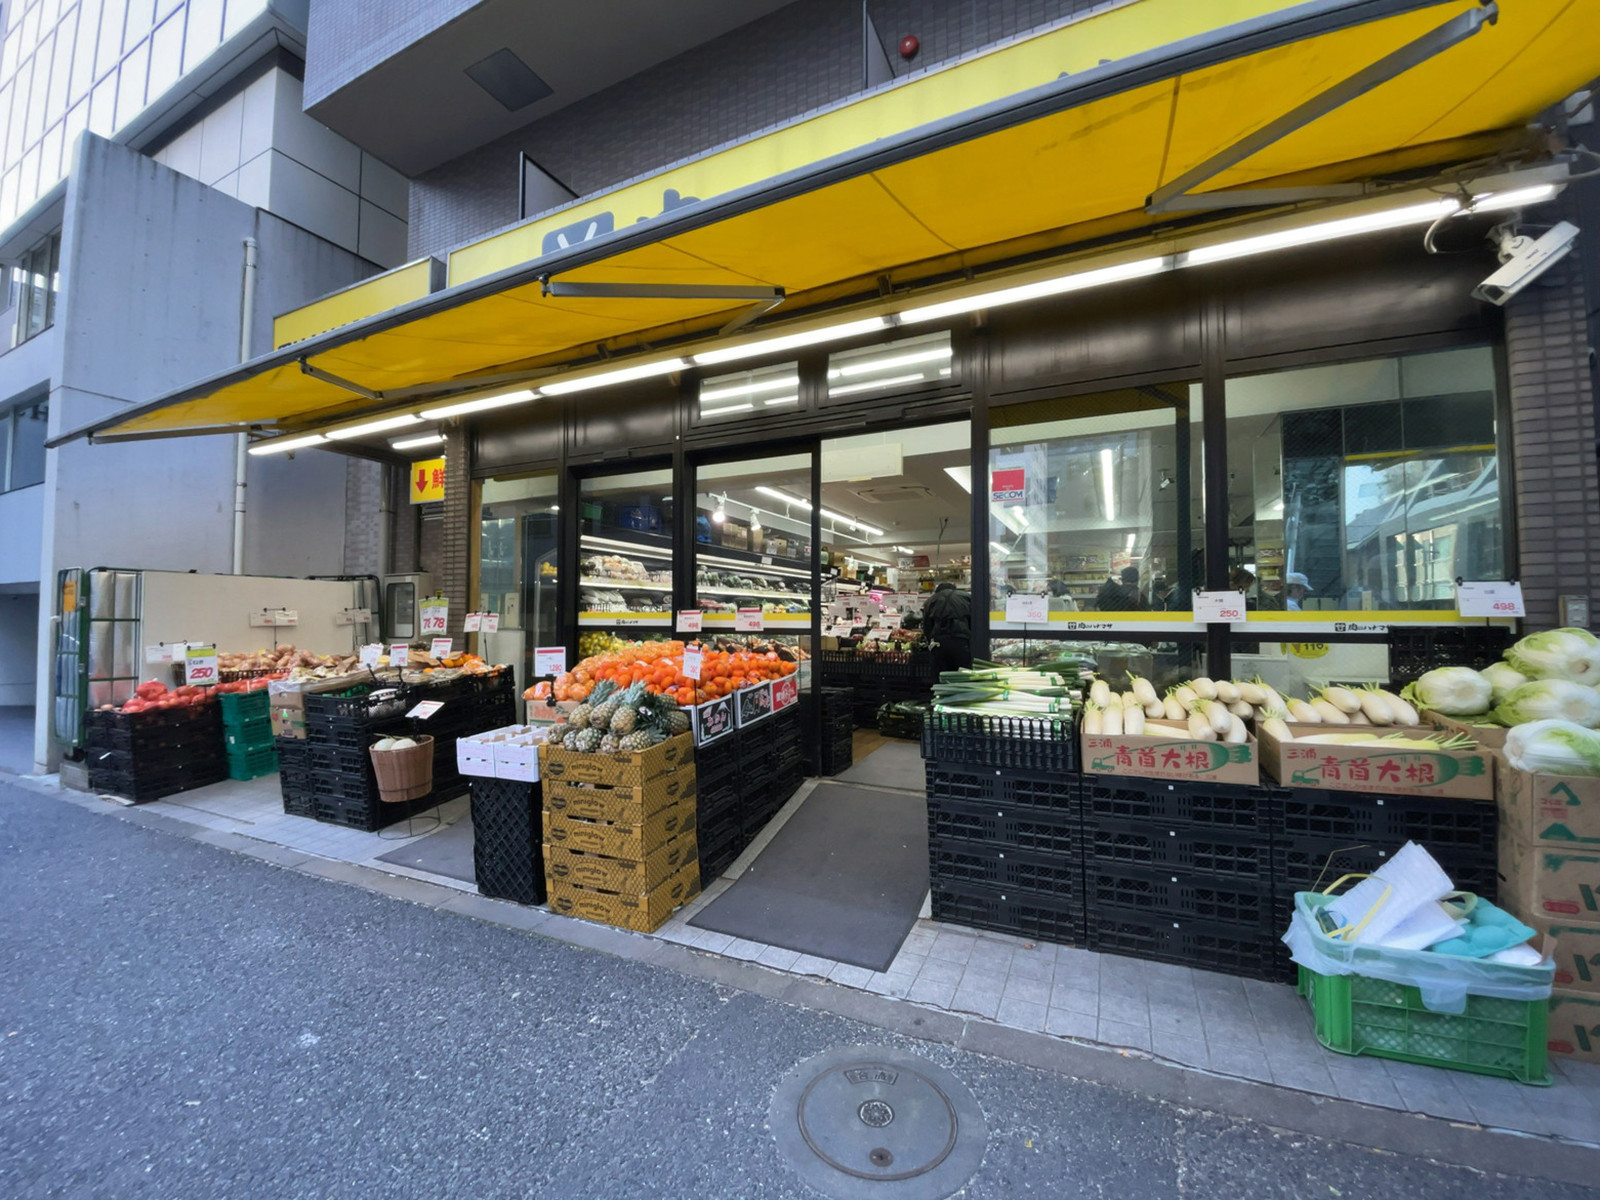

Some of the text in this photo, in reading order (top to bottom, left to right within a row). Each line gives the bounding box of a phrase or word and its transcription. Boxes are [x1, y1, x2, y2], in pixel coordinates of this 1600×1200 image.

[993, 490, 1024, 500] SECOM
[1493, 602, 1515, 611] 498
[1220, 609, 1239, 618] 250
[433, 616, 445, 629] 78
[190, 667, 213, 680] 250
[1088, 738, 1112, 749] 三浦
[1115, 745, 1210, 770] 青首大根
[1287, 748, 1317, 760] 三浦
[571, 760, 604, 773] miniglow
[1318, 755, 1435, 784] 青首大根
[573, 797, 606, 809] miniglow
[573, 829, 606, 842] miniglow
[575, 865, 609, 878] miniglow
[578, 900, 611, 914] miniglow
